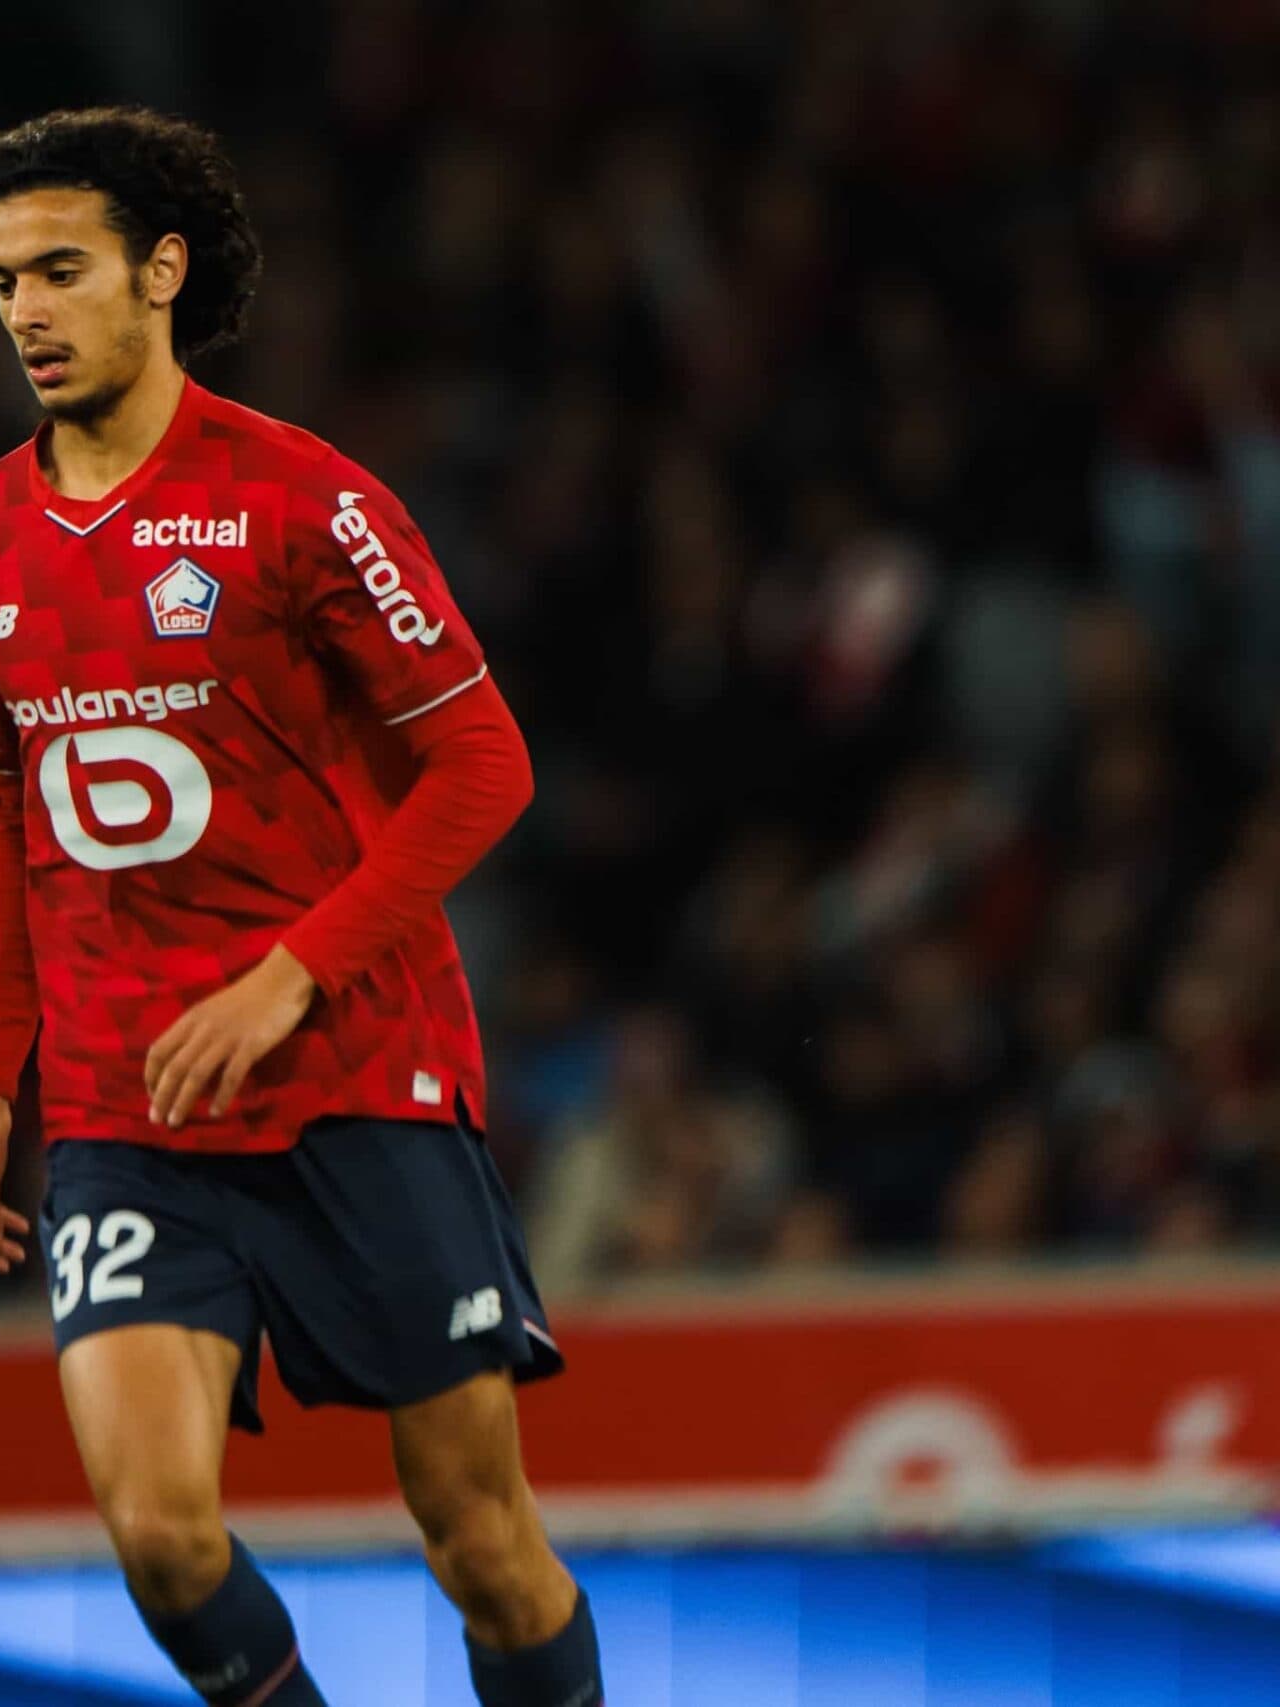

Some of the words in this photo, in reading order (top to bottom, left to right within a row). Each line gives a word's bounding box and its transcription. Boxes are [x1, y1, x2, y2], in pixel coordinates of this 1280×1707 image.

[132, 511, 248, 547] actual
[162, 613, 203, 629] LOSC
[51, 1208, 155, 1322] 32
